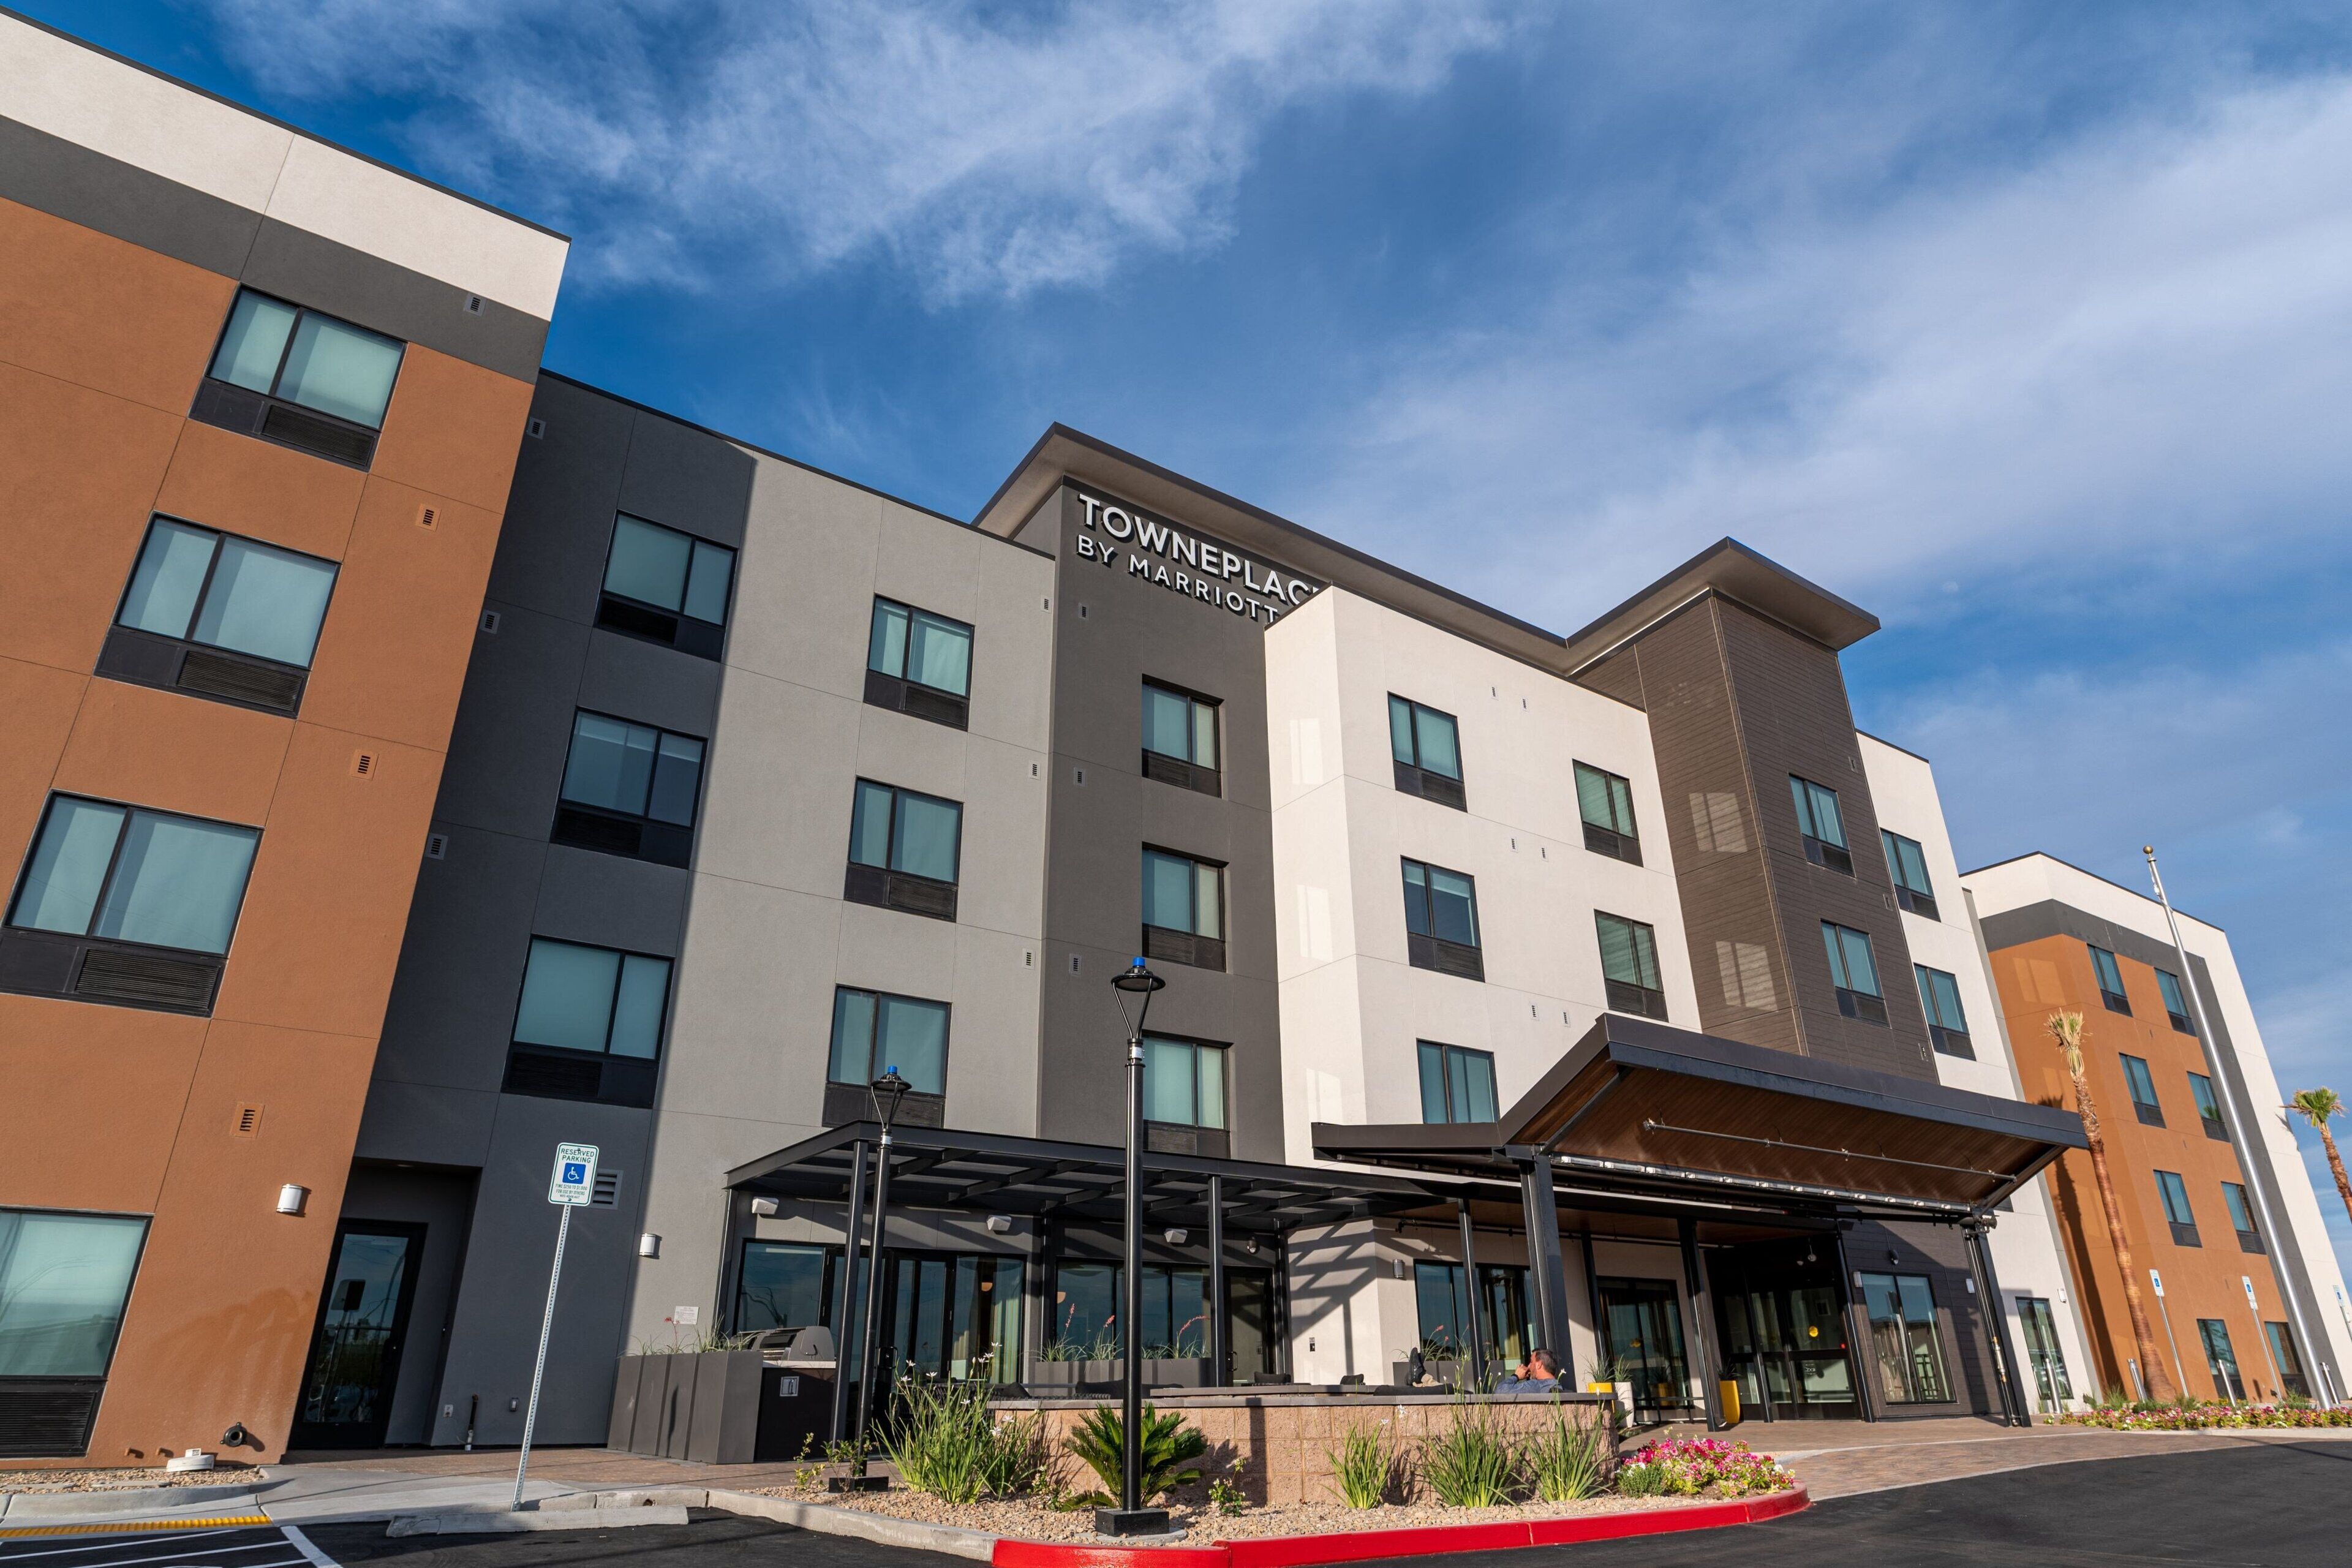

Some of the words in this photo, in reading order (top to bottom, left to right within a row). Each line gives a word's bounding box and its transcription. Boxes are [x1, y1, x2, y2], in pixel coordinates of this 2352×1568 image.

[1079, 494, 1319, 605] TOWNEPLAC
[1079, 534, 1115, 563] BY
[1129, 554, 1278, 623] MARRIOTT
[560, 1148, 594, 1157] RESERVED
